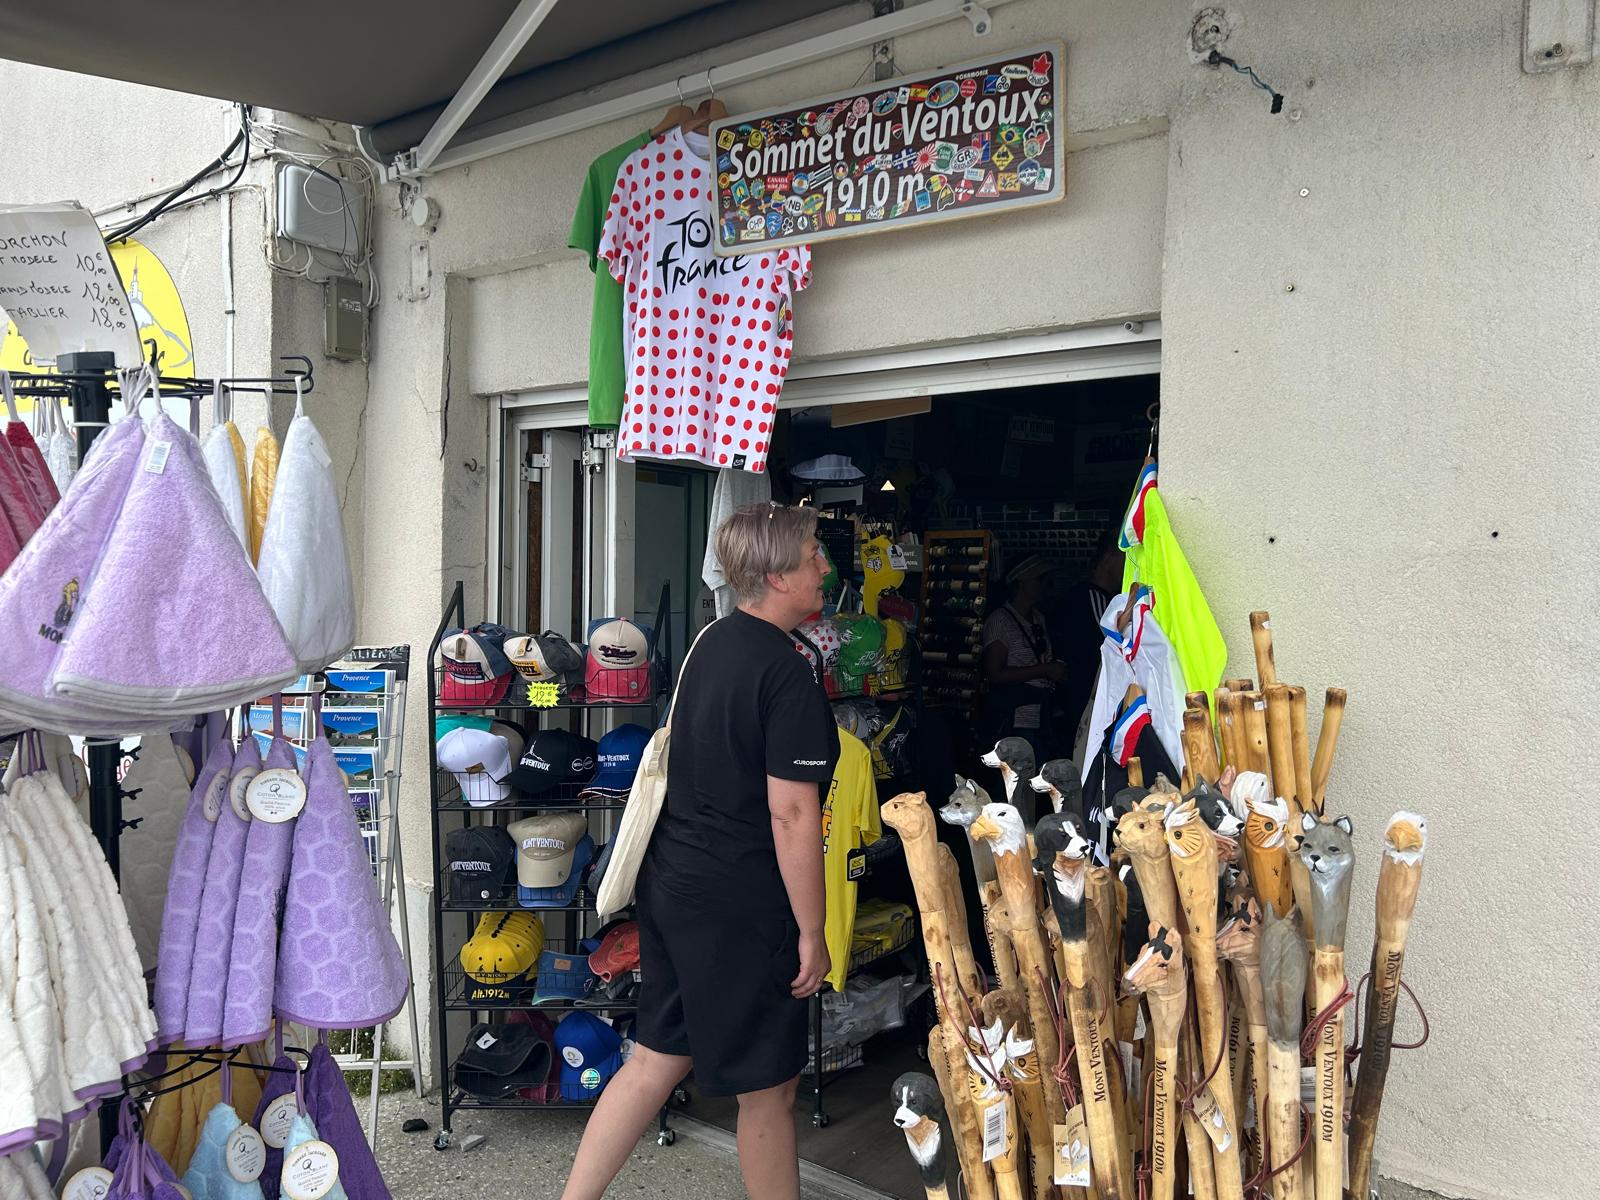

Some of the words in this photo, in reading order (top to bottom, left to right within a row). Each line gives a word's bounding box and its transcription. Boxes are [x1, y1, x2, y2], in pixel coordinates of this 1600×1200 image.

[729, 124, 846, 182] Sommet
[853, 112, 892, 157] du
[900, 87, 1043, 146] Ventoux
[789, 199, 801, 208] NB
[823, 171, 890, 215] 1910
[897, 172, 924, 208] m
[6, 306, 69, 320] TABLIER
[341, 673, 370, 682] Provence
[332, 714, 362, 722] Provence
[537, 837, 566, 850] VENTOUX
[1384, 951, 1400, 987] MONT
[1378, 985, 1397, 1032] VENTOUX
[1088, 1018, 1102, 1070] VENTOUX
[1323, 1014, 1338, 1048] MONT
[1093, 1071, 1107, 1103] MONT
[1155, 1058, 1167, 1092] MONT
[1322, 1050, 1338, 1102] VENTOUX
[1155, 1092, 1168, 1138] VENTOUX
